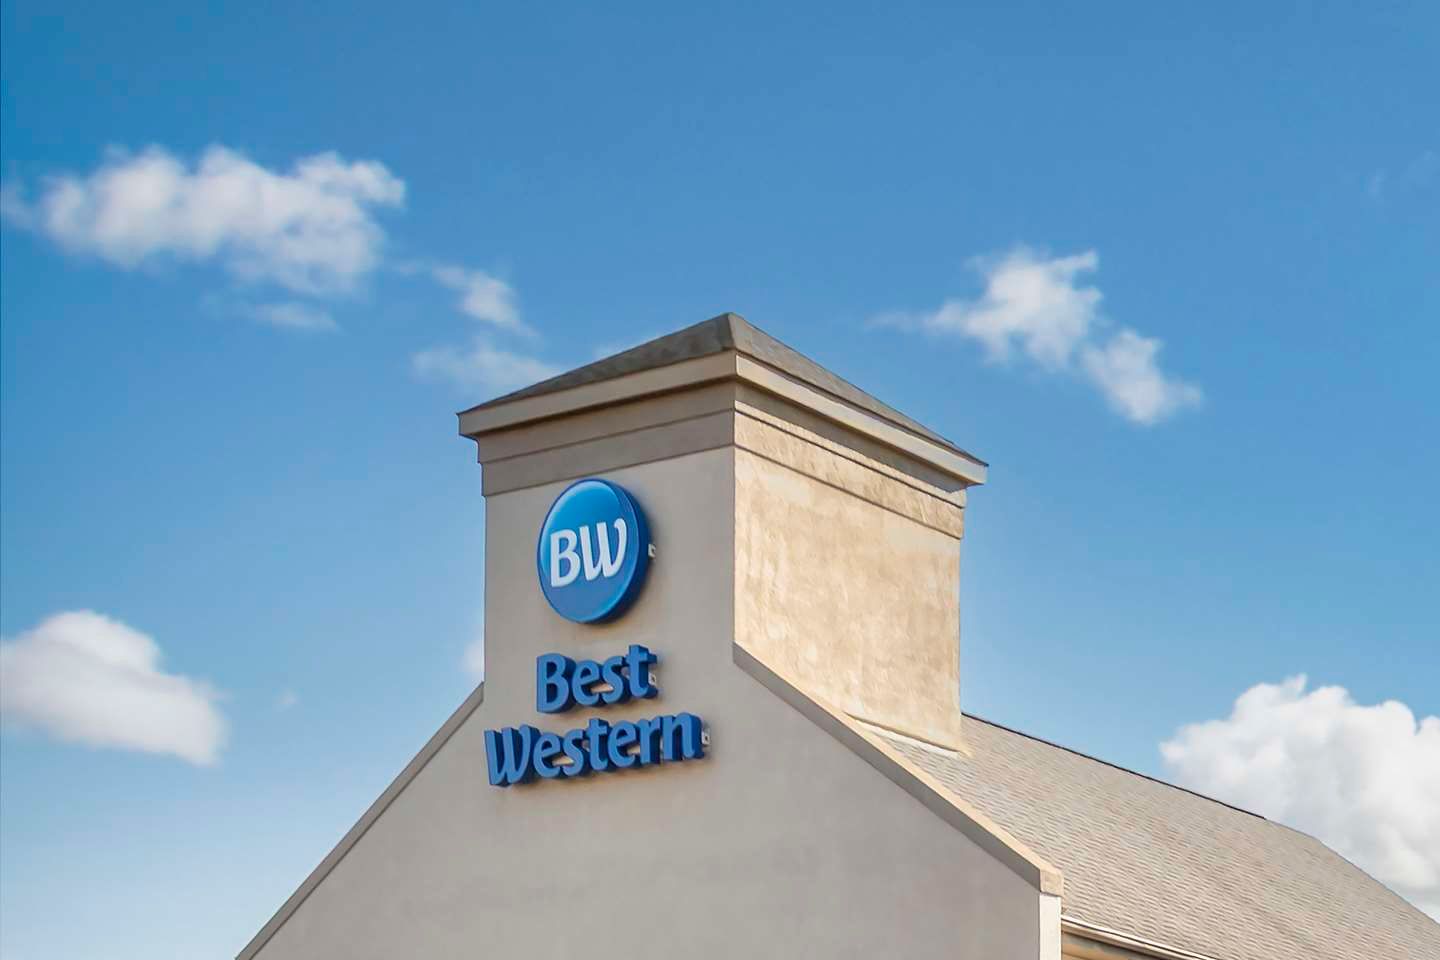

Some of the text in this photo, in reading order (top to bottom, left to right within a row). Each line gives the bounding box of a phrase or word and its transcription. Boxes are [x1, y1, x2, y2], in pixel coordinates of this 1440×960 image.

[550, 518, 627, 587] BW
[537, 644, 657, 714] Best
[484, 712, 704, 787] Western
